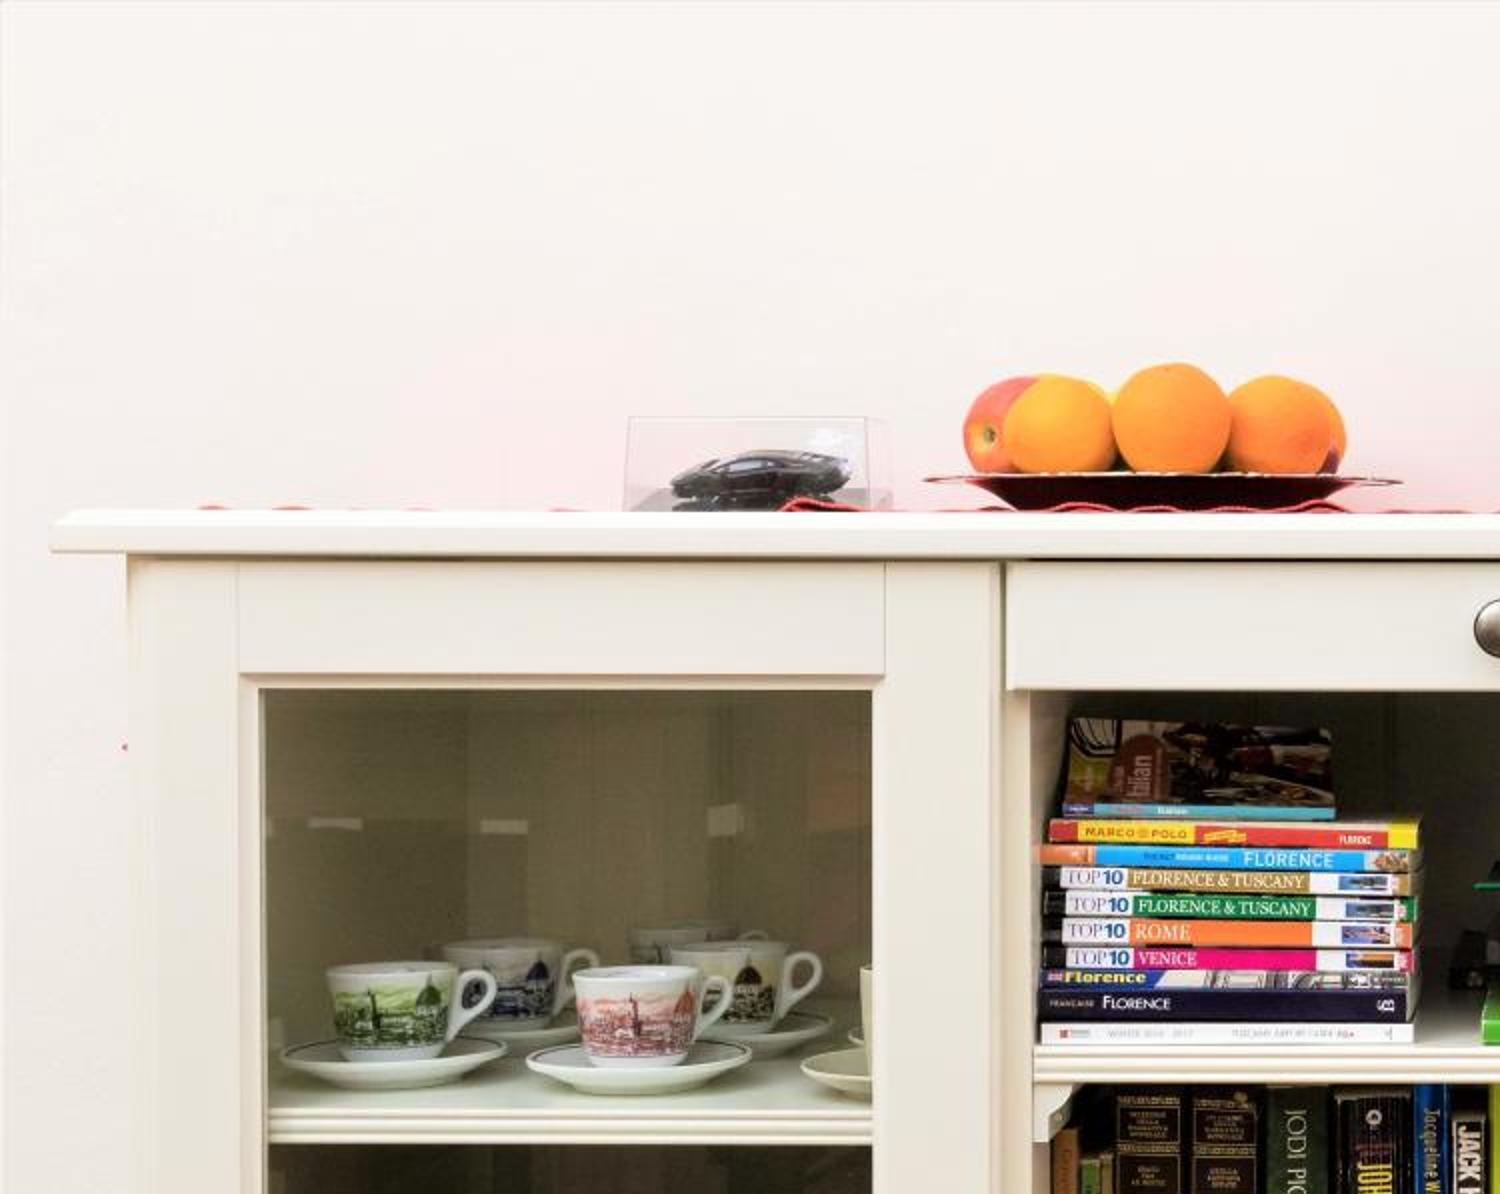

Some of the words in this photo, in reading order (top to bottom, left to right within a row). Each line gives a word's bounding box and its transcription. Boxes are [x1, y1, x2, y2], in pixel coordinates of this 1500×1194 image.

[1085, 827, 1134, 838] MARCO
[1151, 828, 1187, 839] POLO
[1243, 853, 1334, 868] FLORENCE
[1132, 872, 1214, 886] FLORENCE
[1217, 874, 1229, 887] &
[1231, 874, 1305, 888] TUSCANY
[1138, 899, 1221, 913] FLORENCE
[1223, 902, 1235, 914] &
[1238, 901, 1311, 916] TUSCANY
[1135, 923, 1191, 939] ROME
[1139, 951, 1197, 966] VENICE
[1065, 970, 1147, 983] Florence
[1102, 995, 1171, 1010] FLORENCE
[1284, 1109, 1307, 1159] JODI
[1421, 1108, 1441, 1177] Jacqueline
[1458, 1125, 1481, 1181] JACK
